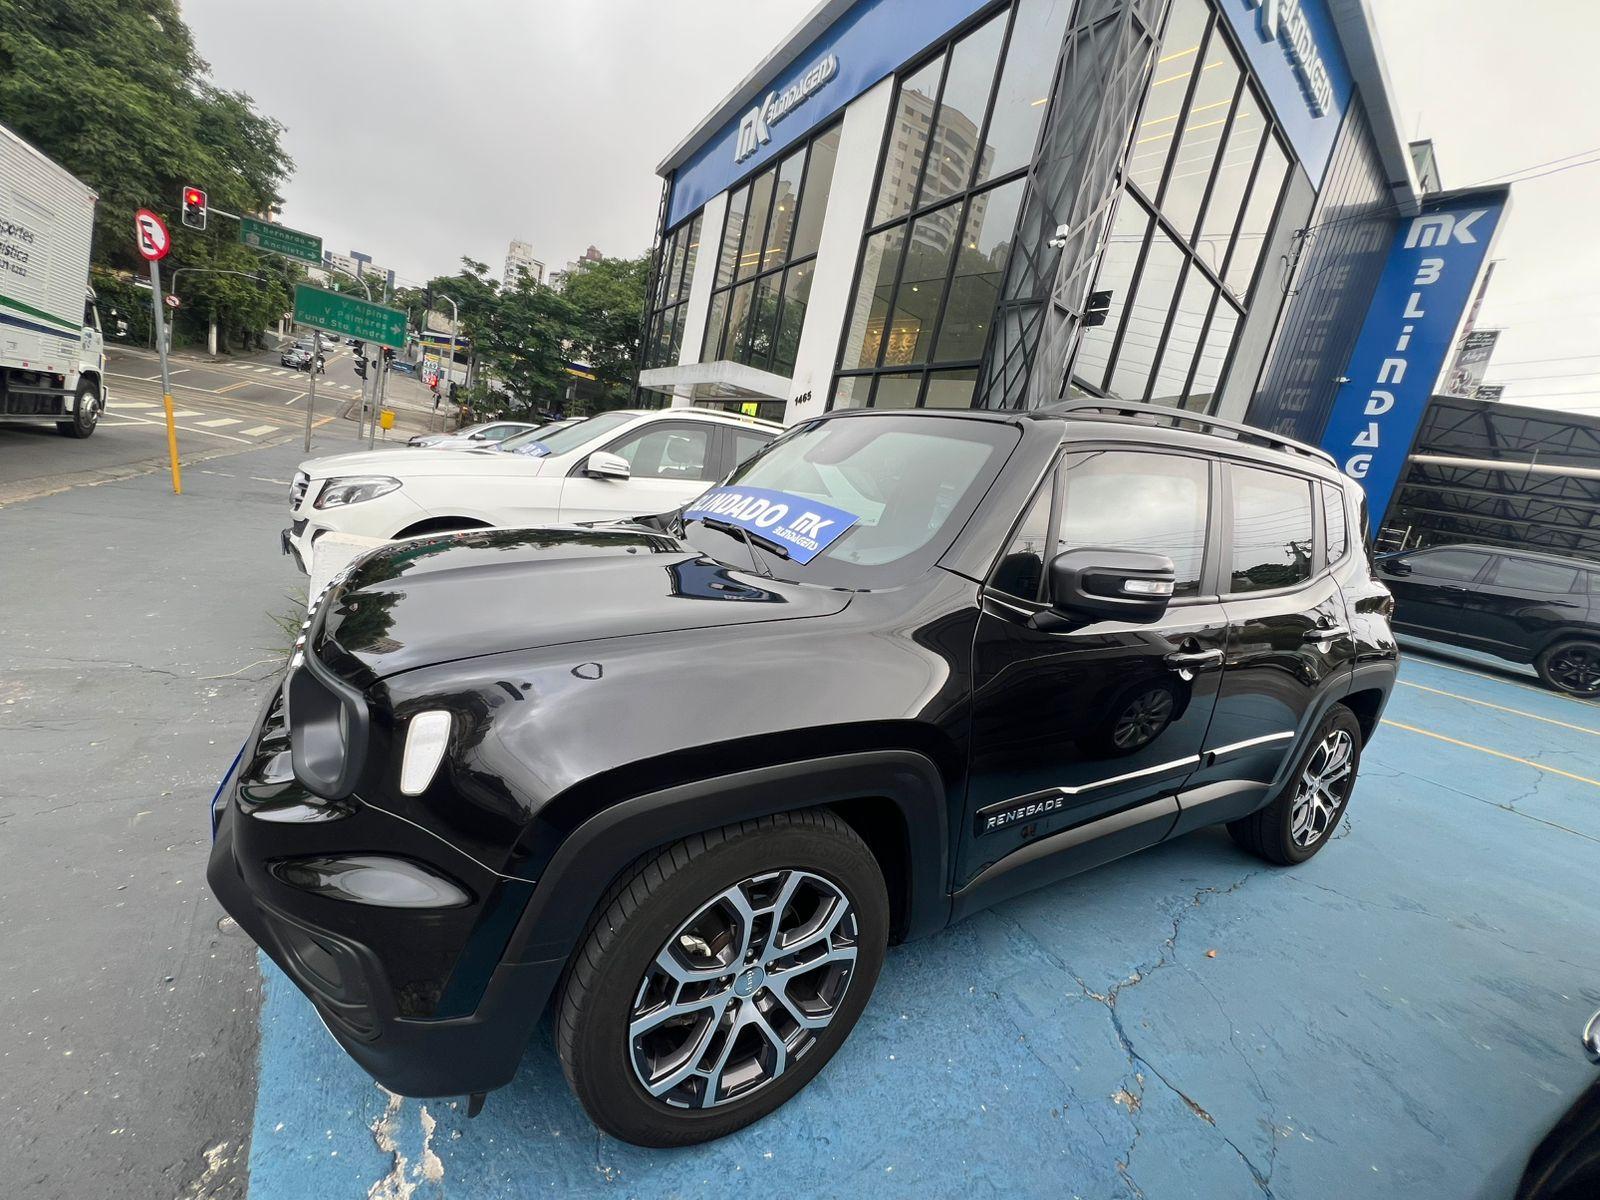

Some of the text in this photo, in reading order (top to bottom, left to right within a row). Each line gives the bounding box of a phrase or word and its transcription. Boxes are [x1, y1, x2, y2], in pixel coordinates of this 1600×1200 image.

[263, 226, 305, 244] Bernardo
[1404, 210, 1488, 249] MK
[356, 305, 388, 320] Alpina
[794, 390, 812, 406] 1465
[986, 798, 1064, 829] RENEGADE
